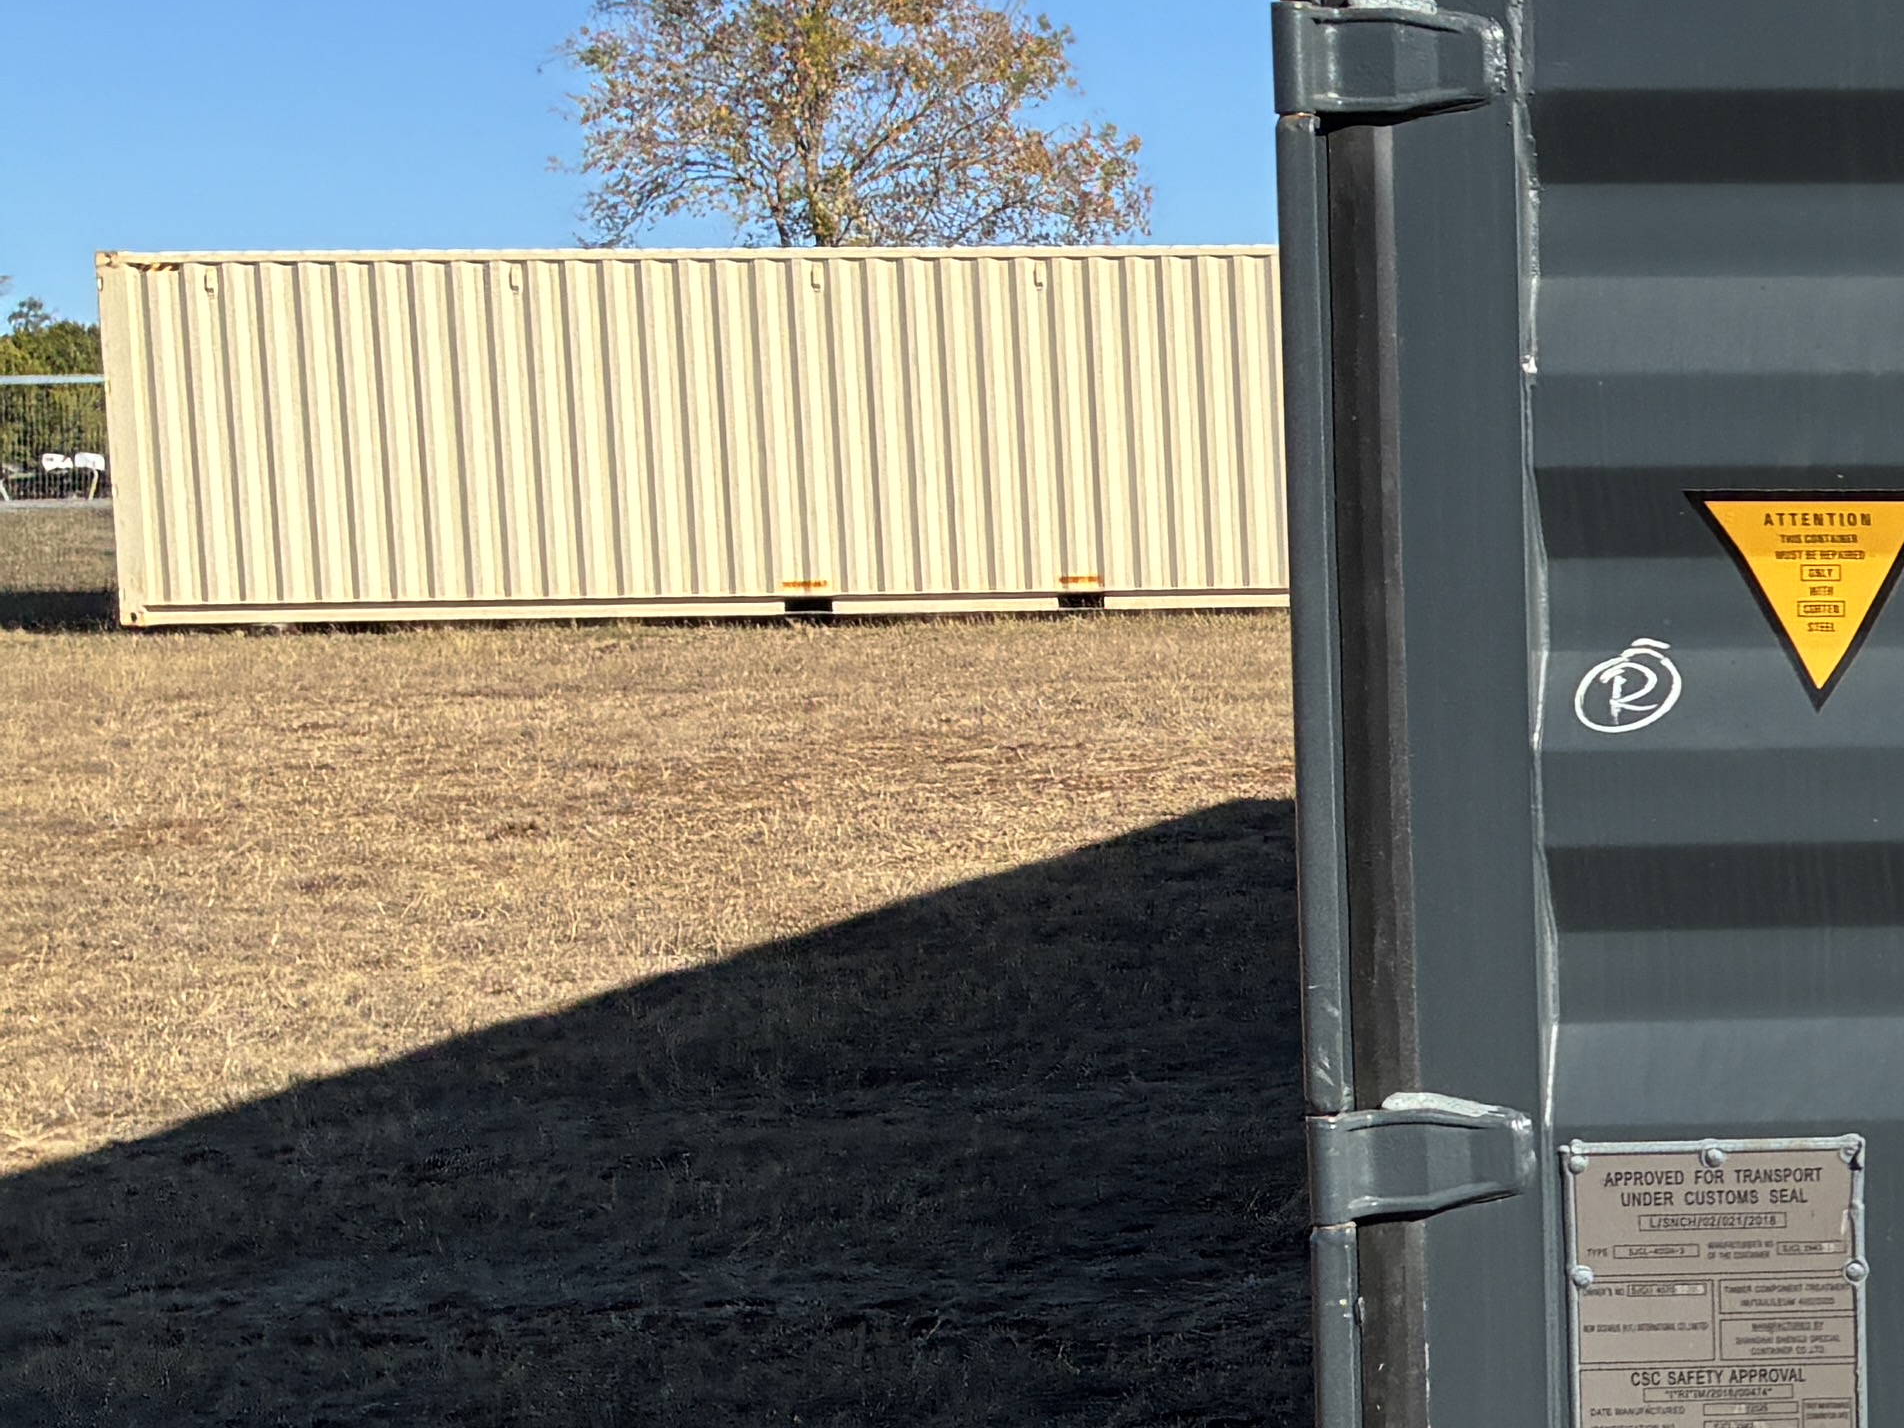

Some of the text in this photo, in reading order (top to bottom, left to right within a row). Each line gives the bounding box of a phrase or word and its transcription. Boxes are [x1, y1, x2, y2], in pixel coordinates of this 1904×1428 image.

[1763, 512, 1872, 527] ATTENTION
[1603, 1167, 1823, 1187] APPROVED FOR TRANSPORT
[1621, 1188, 1808, 1207] UNDER CUSTOMS SEAL
[1631, 1368, 1806, 1386] CSC SAFETY APPROVAL
[1590, 1407, 1612, 1416] DATE
